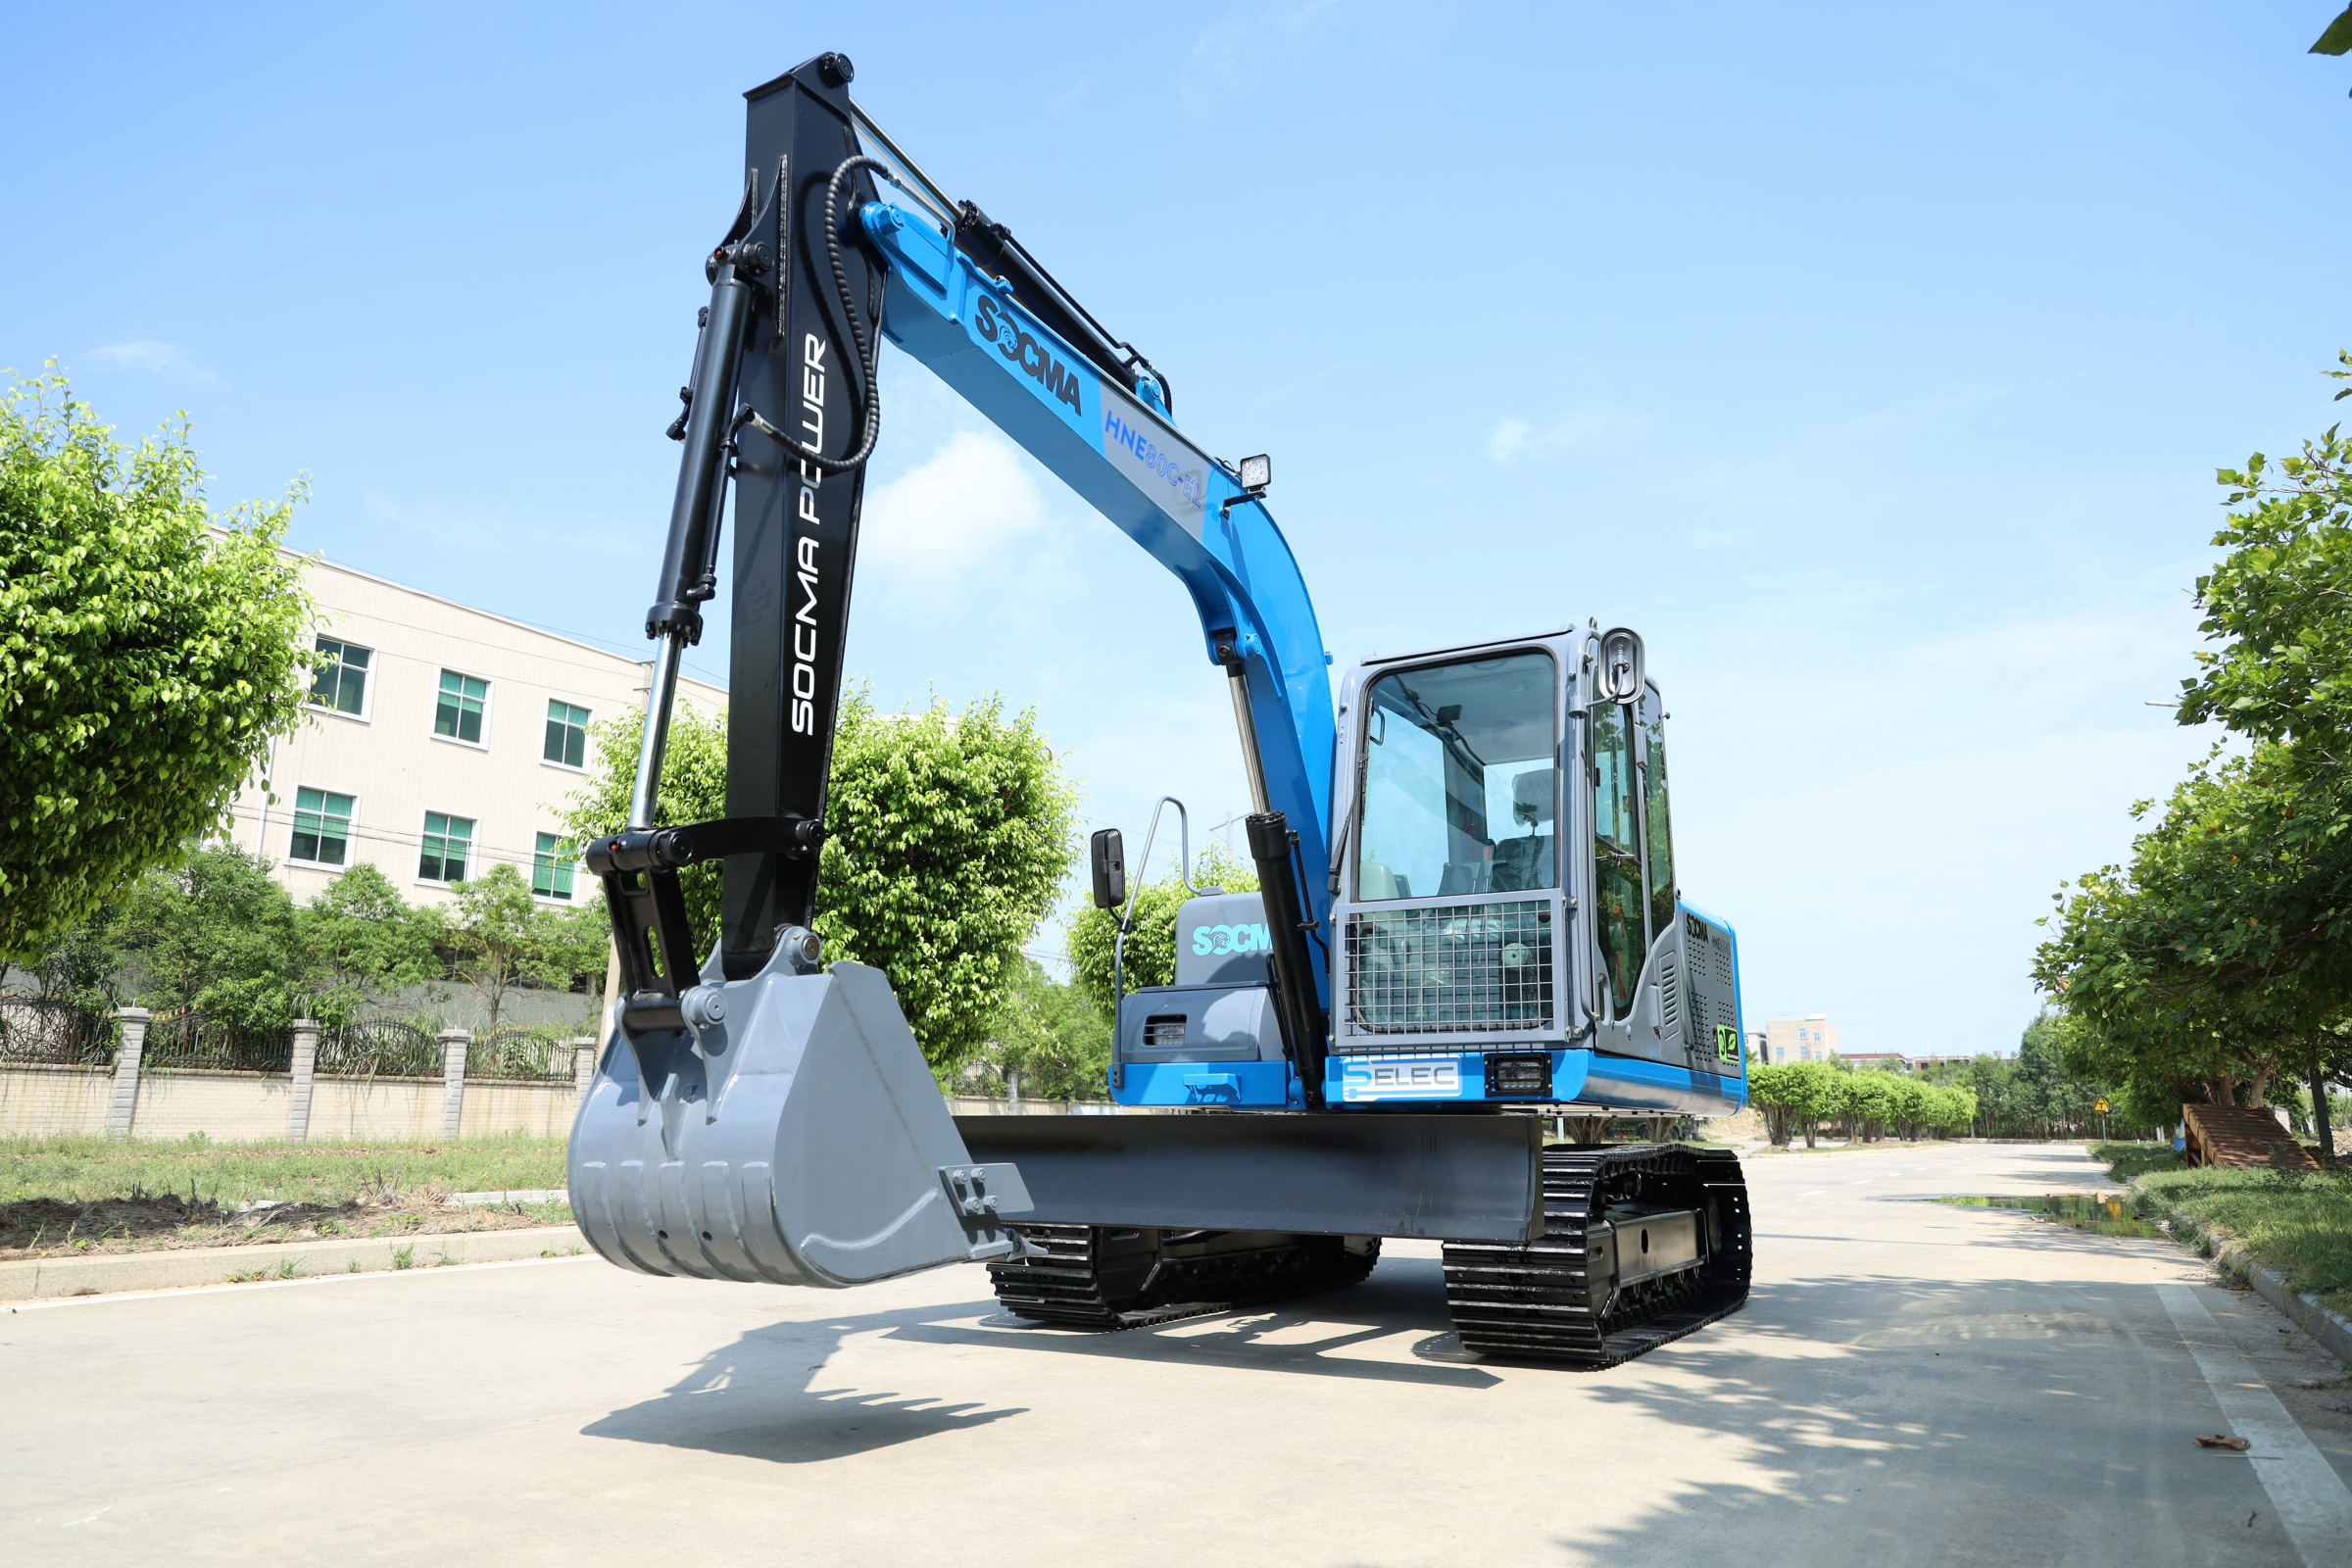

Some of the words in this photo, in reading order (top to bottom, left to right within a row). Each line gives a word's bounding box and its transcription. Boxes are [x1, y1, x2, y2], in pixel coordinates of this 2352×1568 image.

[975, 295, 1082, 416] SOCMA
[1104, 410, 1201, 508] HNE80C-EL
[792, 535, 819, 736] SOCMA
[1192, 923, 1273, 956] SOCM
[1687, 912, 1709, 944] SOCMA
[1343, 1061, 1454, 1088] SELEC
